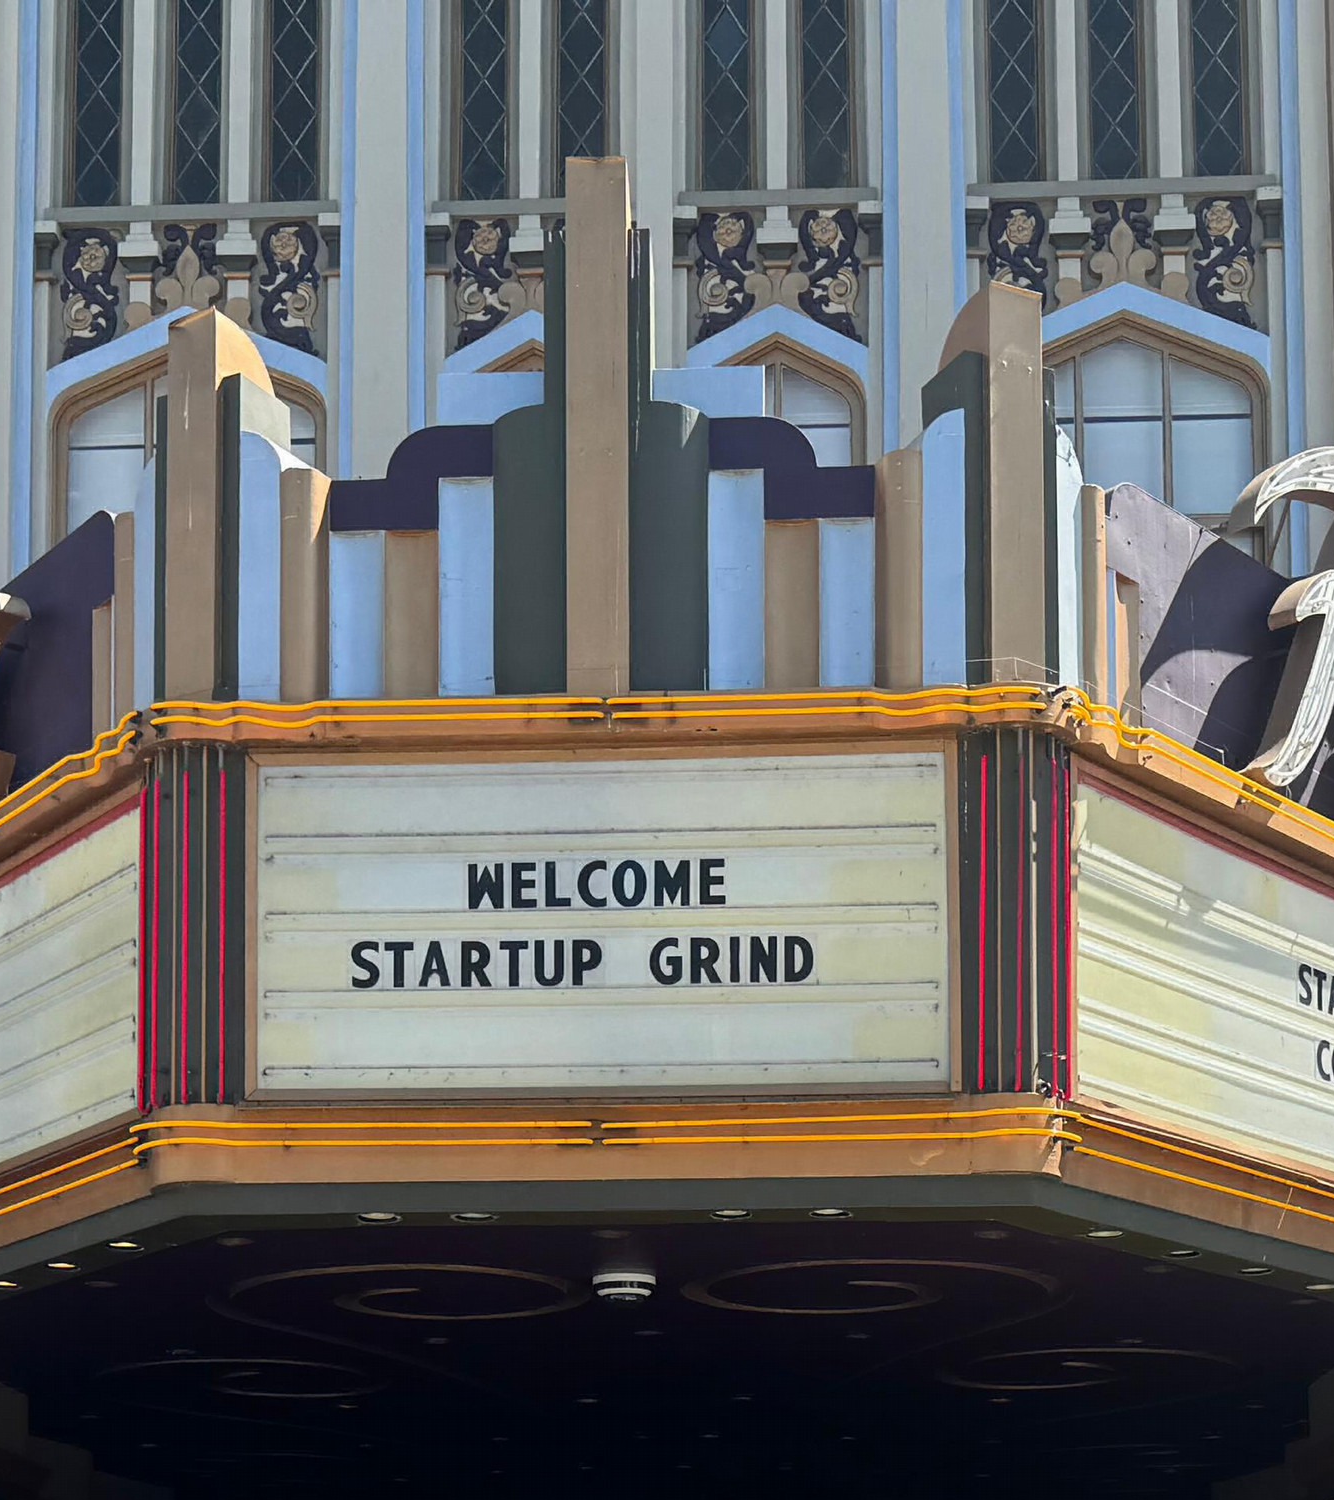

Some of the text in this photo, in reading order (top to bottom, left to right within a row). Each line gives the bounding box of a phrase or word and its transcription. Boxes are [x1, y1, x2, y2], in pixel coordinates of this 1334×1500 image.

[467, 858, 726, 910] WELCOME
[351, 936, 815, 988] STARTUP GRIND
